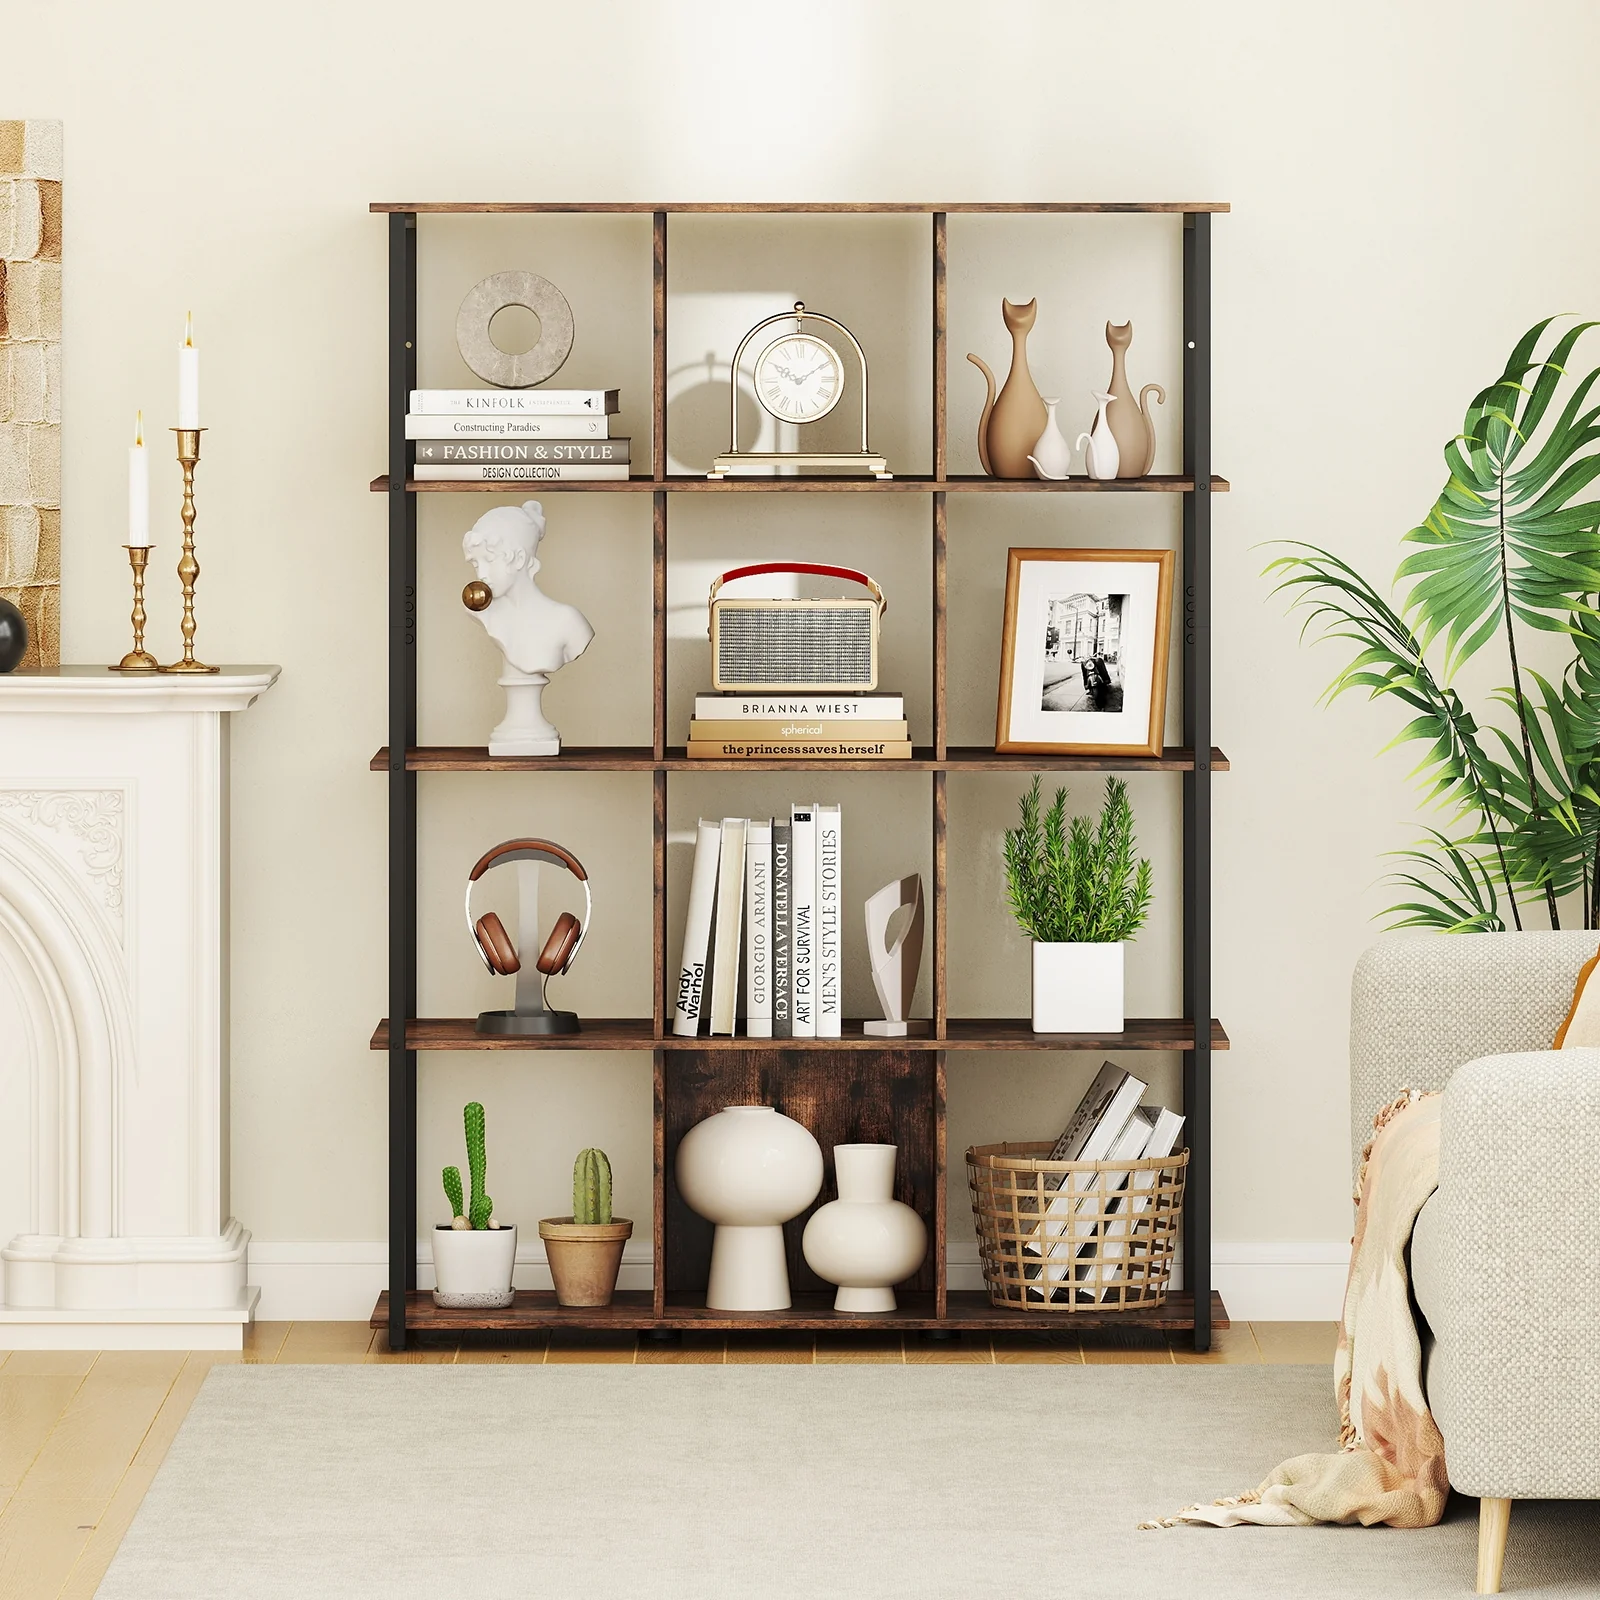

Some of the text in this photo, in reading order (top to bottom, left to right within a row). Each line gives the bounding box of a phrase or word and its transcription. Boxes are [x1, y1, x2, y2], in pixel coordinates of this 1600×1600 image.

[467, 398, 524, 408] KINFOLK
[454, 423, 540, 434] Constructing Paradies
[444, 446, 612, 458] FASHION & STYLE
[482, 467, 561, 478] DESIGN COLLECTION
[743, 705, 858, 713] BRIANNA WIEST
[781, 724, 823, 736] spherical
[722, 744, 744, 755] the
[746, 744, 800, 756] princess
[839, 744, 885, 754] herself
[822, 830, 836, 1013] MEN'S STYLE STORIES
[754, 862, 765, 1004] GIORGIO ARMANI
[776, 844, 787, 1019] DONATELLA VERSACE
[797, 905, 810, 1023] ART FOR SURVIVAL
[675, 967, 693, 1012] Andy
[686, 962, 704, 1020] Warhol
